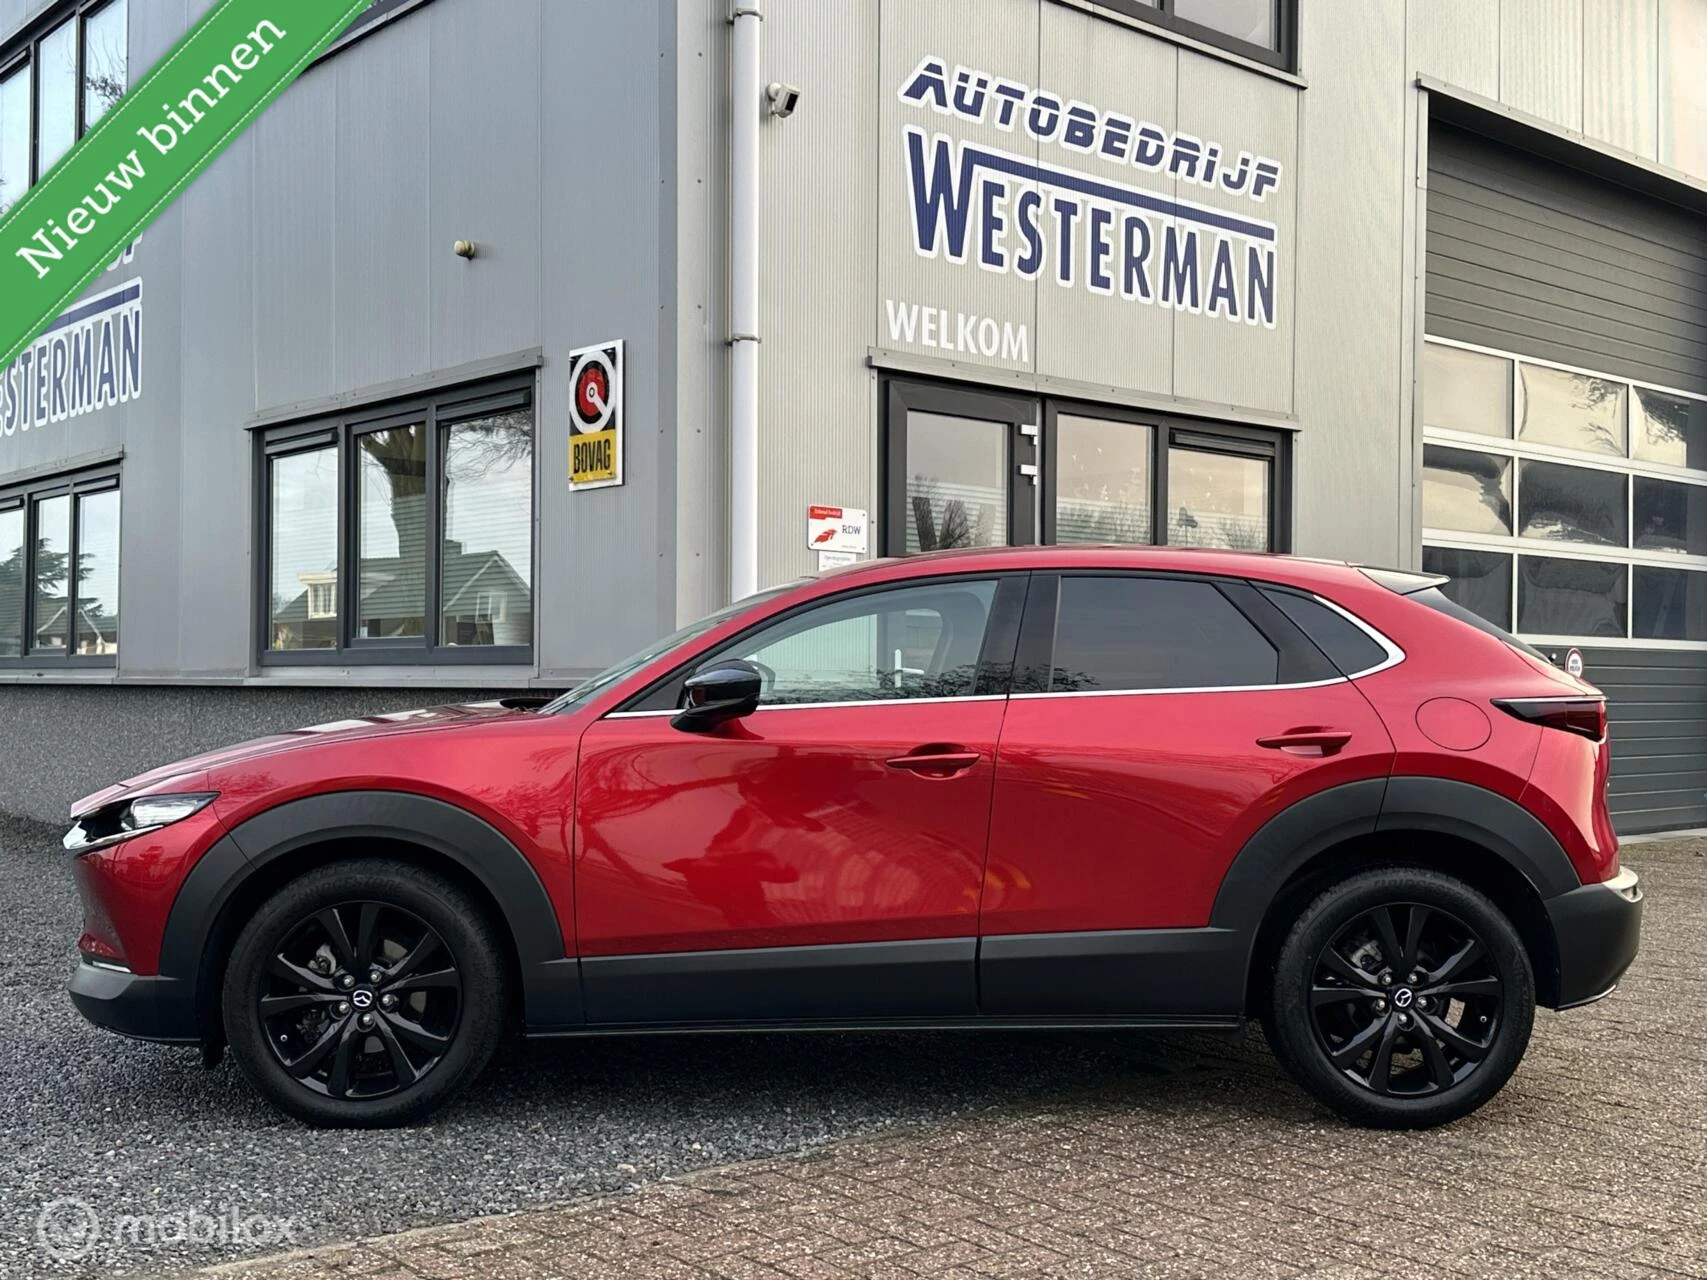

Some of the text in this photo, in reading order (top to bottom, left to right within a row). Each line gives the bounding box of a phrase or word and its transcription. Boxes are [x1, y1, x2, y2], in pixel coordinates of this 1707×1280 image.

[906, 129, 1275, 325] WESTERMAN
[885, 299, 1029, 363] WELKOM
[0, 309, 141, 434] STERMAN
[573, 438, 611, 474] BOVAG
[841, 524, 862, 535] RDW
